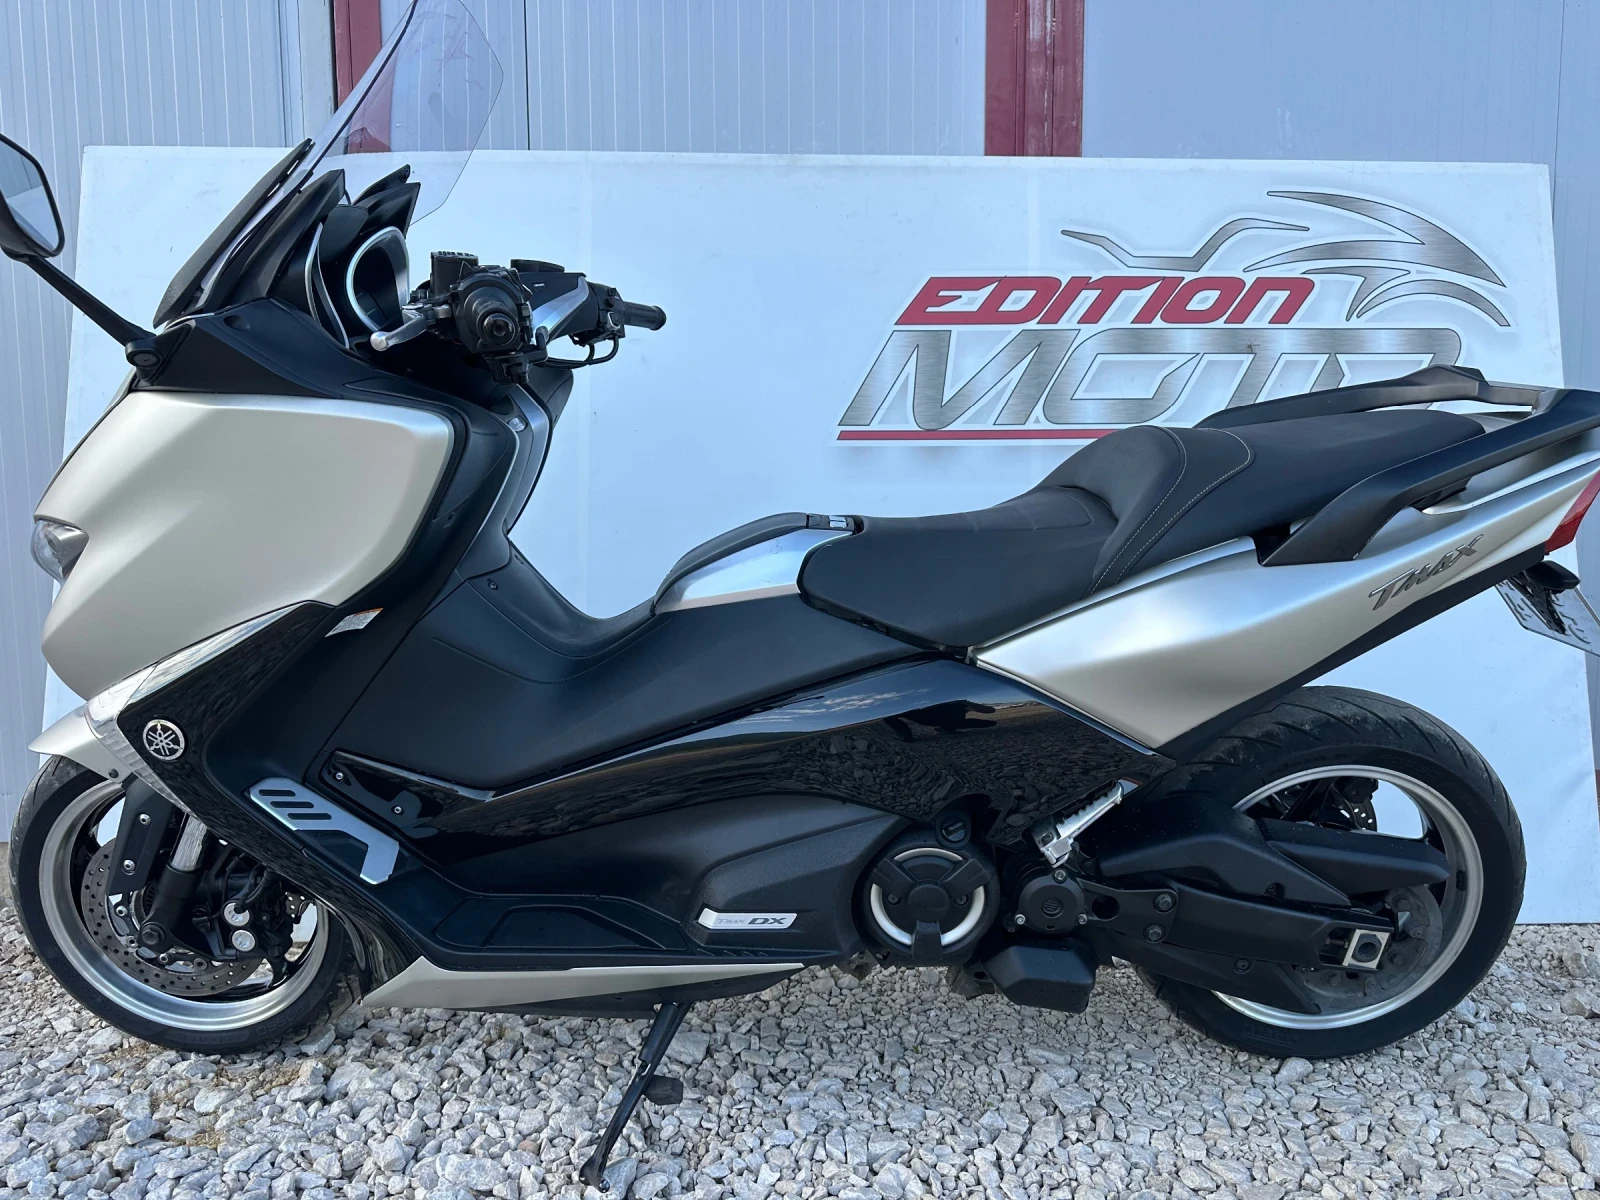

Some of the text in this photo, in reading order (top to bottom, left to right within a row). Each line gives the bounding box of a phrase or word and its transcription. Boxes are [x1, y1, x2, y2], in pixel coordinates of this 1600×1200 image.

[895, 276, 1315, 325] EDITION
[838, 328, 1461, 430] MOTO
[747, 917, 787, 925] DX
